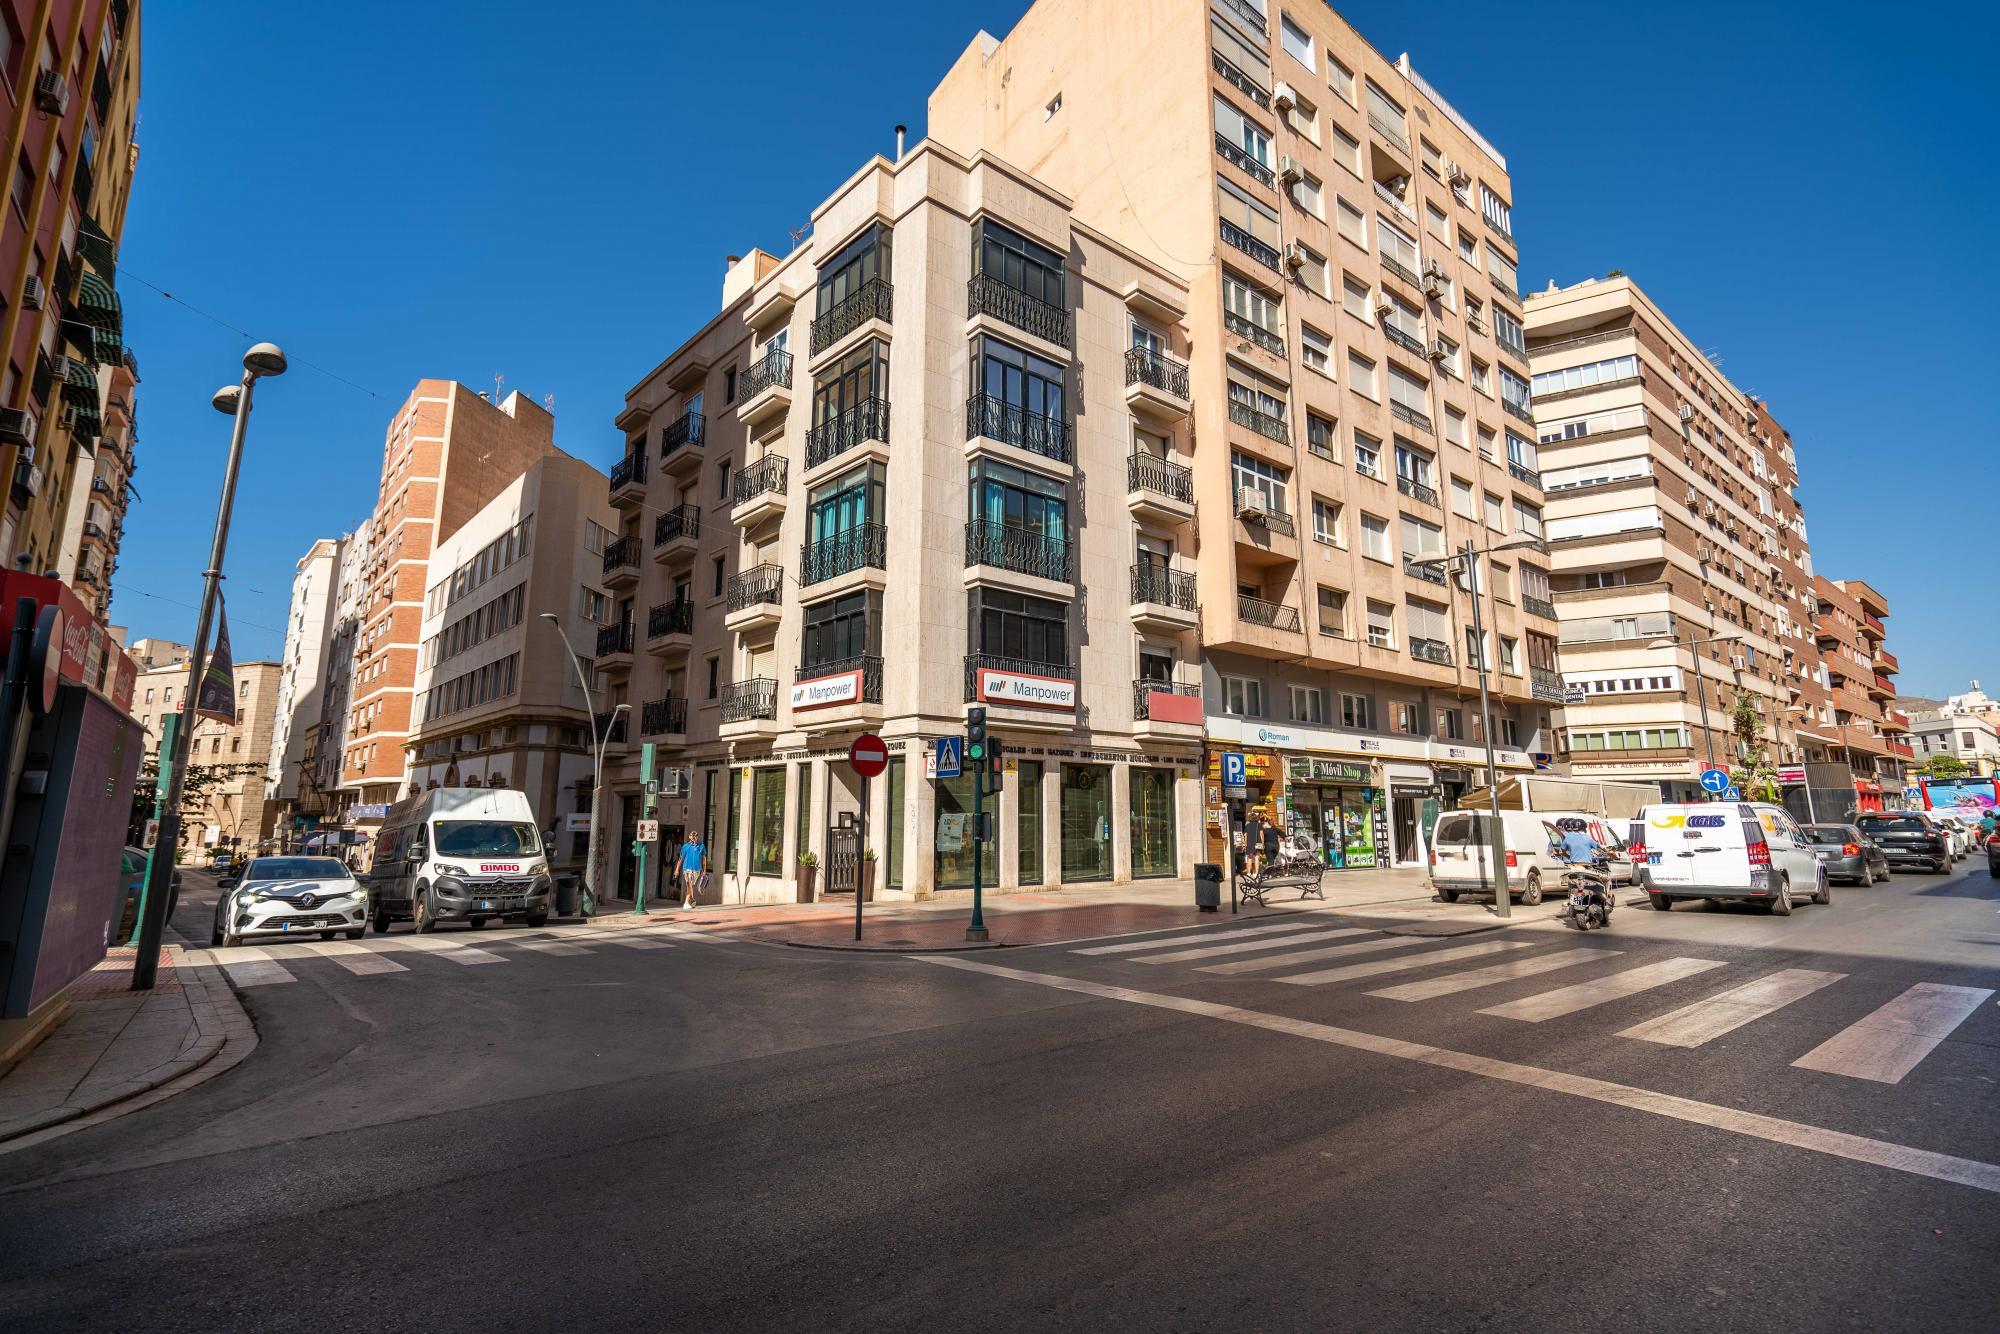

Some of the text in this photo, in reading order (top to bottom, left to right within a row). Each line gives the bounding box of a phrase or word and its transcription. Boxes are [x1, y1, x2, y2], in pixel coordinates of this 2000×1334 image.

[809, 683, 852, 700] Manpower
[1014, 681, 1071, 700] Manpower
[1267, 732, 1290, 741] Roman
[1227, 756, 1241, 782] P
[1321, 762, 1361, 780] Móvil Shop
